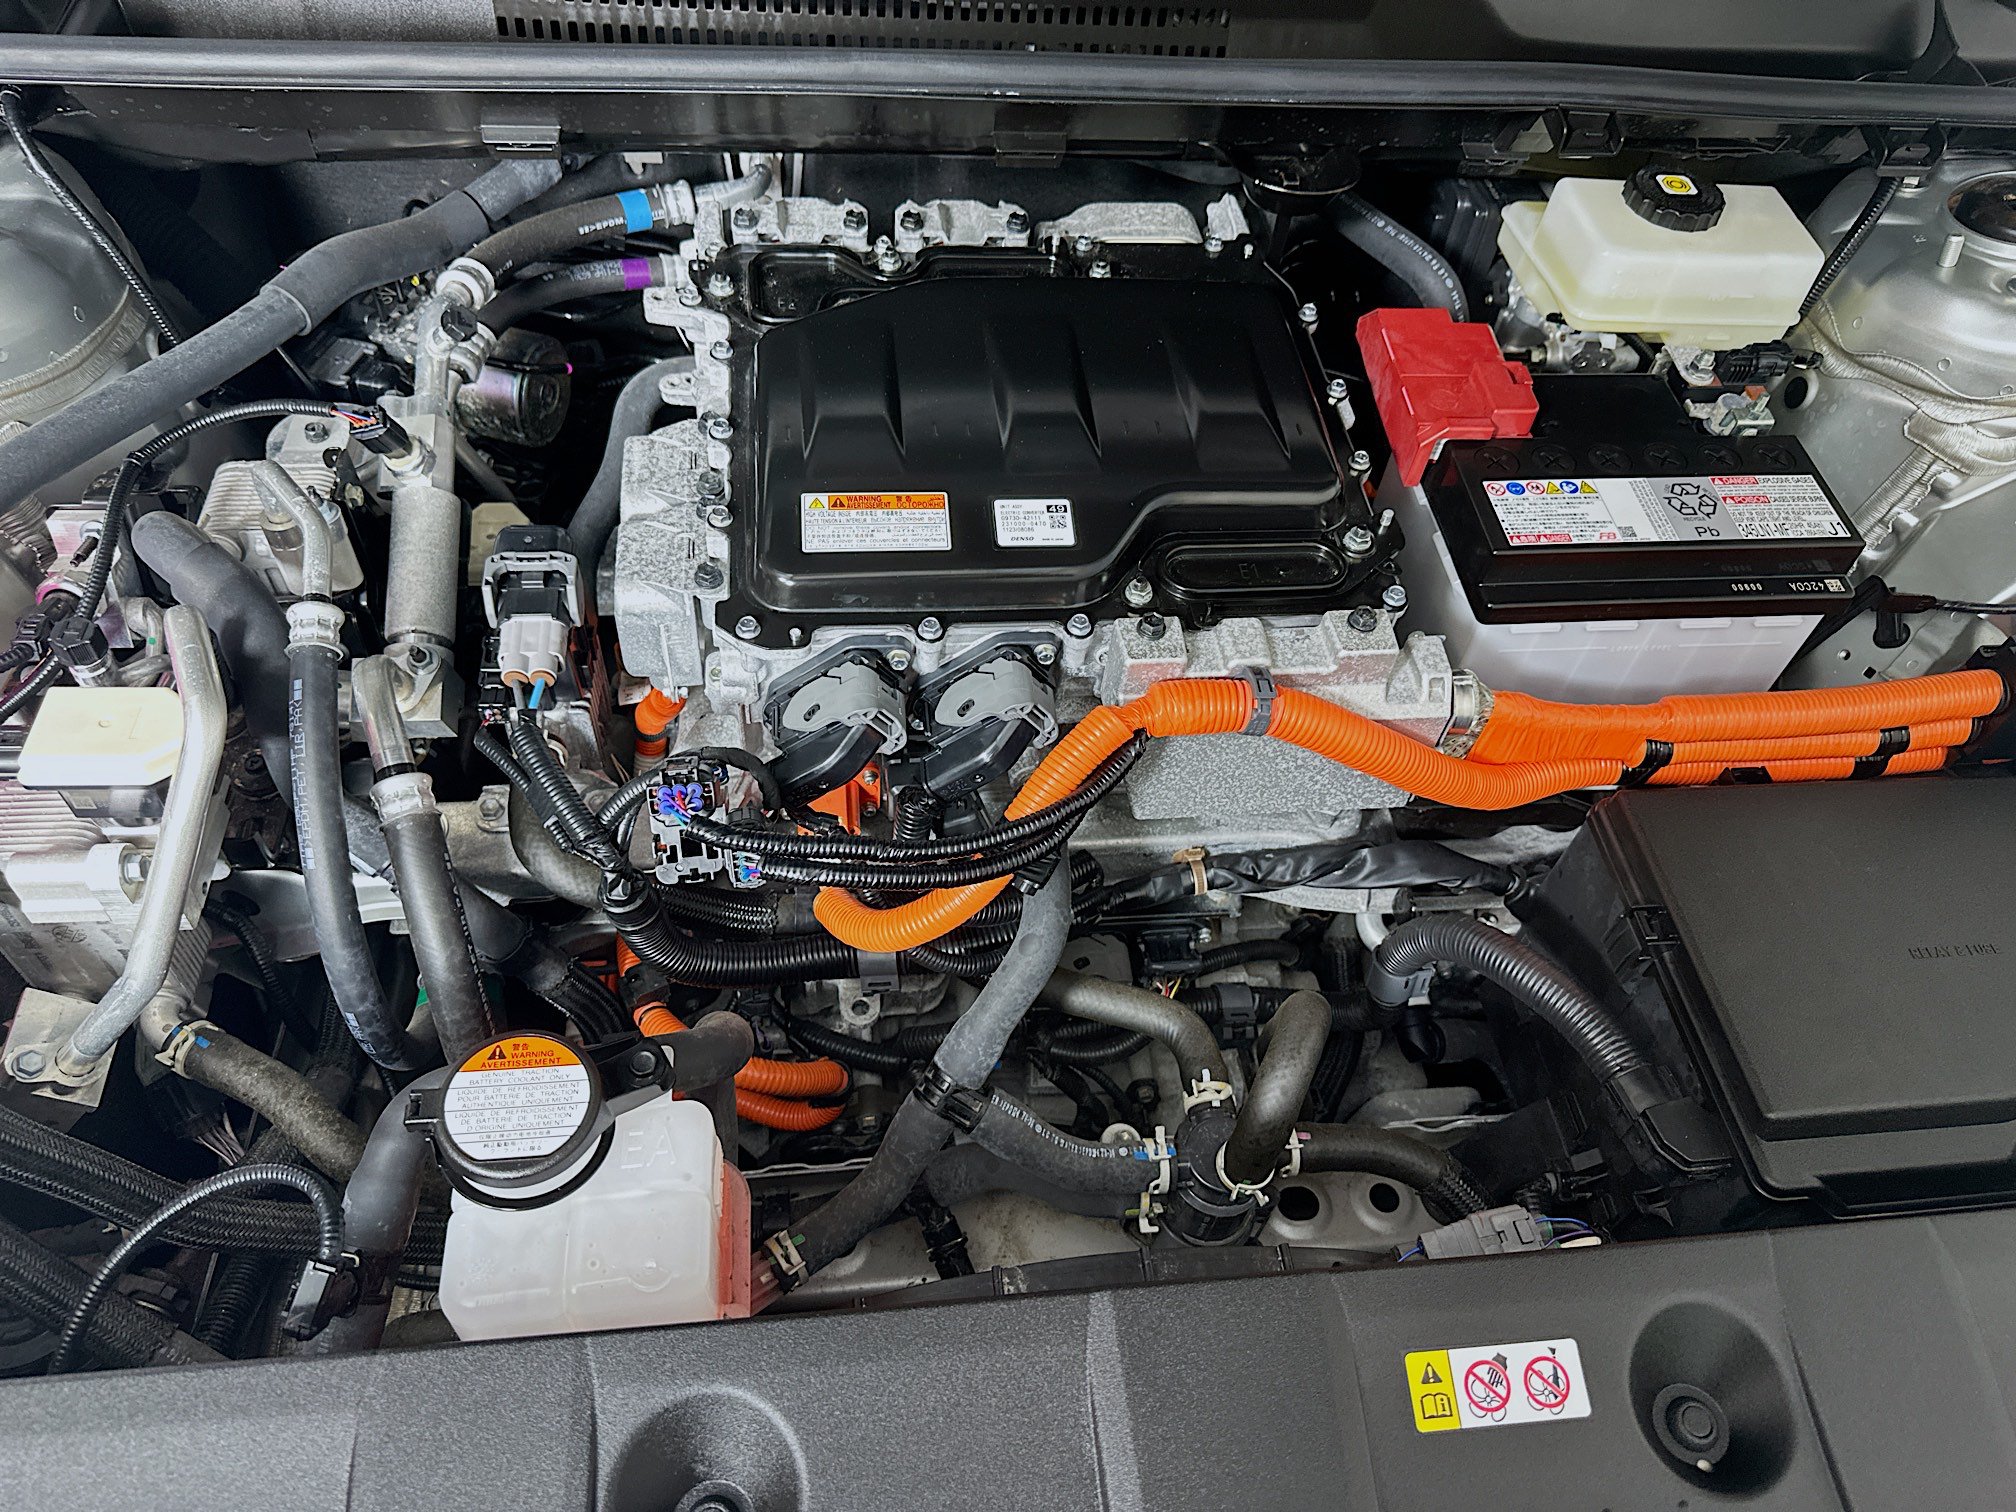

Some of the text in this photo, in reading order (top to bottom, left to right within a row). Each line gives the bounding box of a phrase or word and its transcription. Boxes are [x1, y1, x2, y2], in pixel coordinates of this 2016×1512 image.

[1759, 476, 1792, 484] EXPLOSIVE
[1048, 505, 1066, 513] 49
[1694, 526, 1721, 538] Pb
[1828, 521, 1849, 536] J1
[1239, 563, 1259, 579] E1
[512, 1043, 529, 1051] 警告
[511, 1050, 554, 1059] WARNING
[480, 1057, 561, 1069] AVERTISSEMENT
[469, 1073, 571, 1086] BATTERY COOLANT ONLY
[481, 1069, 560, 1079] GENUINE TRACTION
[457, 1088, 487, 1096] LIQUIDE
[508, 1081, 580, 1093] REFROIDISSEMENT
[484, 1093, 520, 1101] BATTERIE
[541, 1088, 579, 1097] TRACTION
[462, 1096, 574, 1109] AUTHENTIQUE UNIQUEMENT
[455, 1111, 485, 1119] LIQUIDE
[505, 1104, 579, 1115] REFROIDISSEMENT
[460, 1118, 471, 1126] DE
[476, 1116, 513, 1124] BATTERIE
[533, 1112, 572, 1120] TRACTION
[511, 1120, 565, 1129] UNIQUEMENT
[620, 1127, 678, 1169] EA
